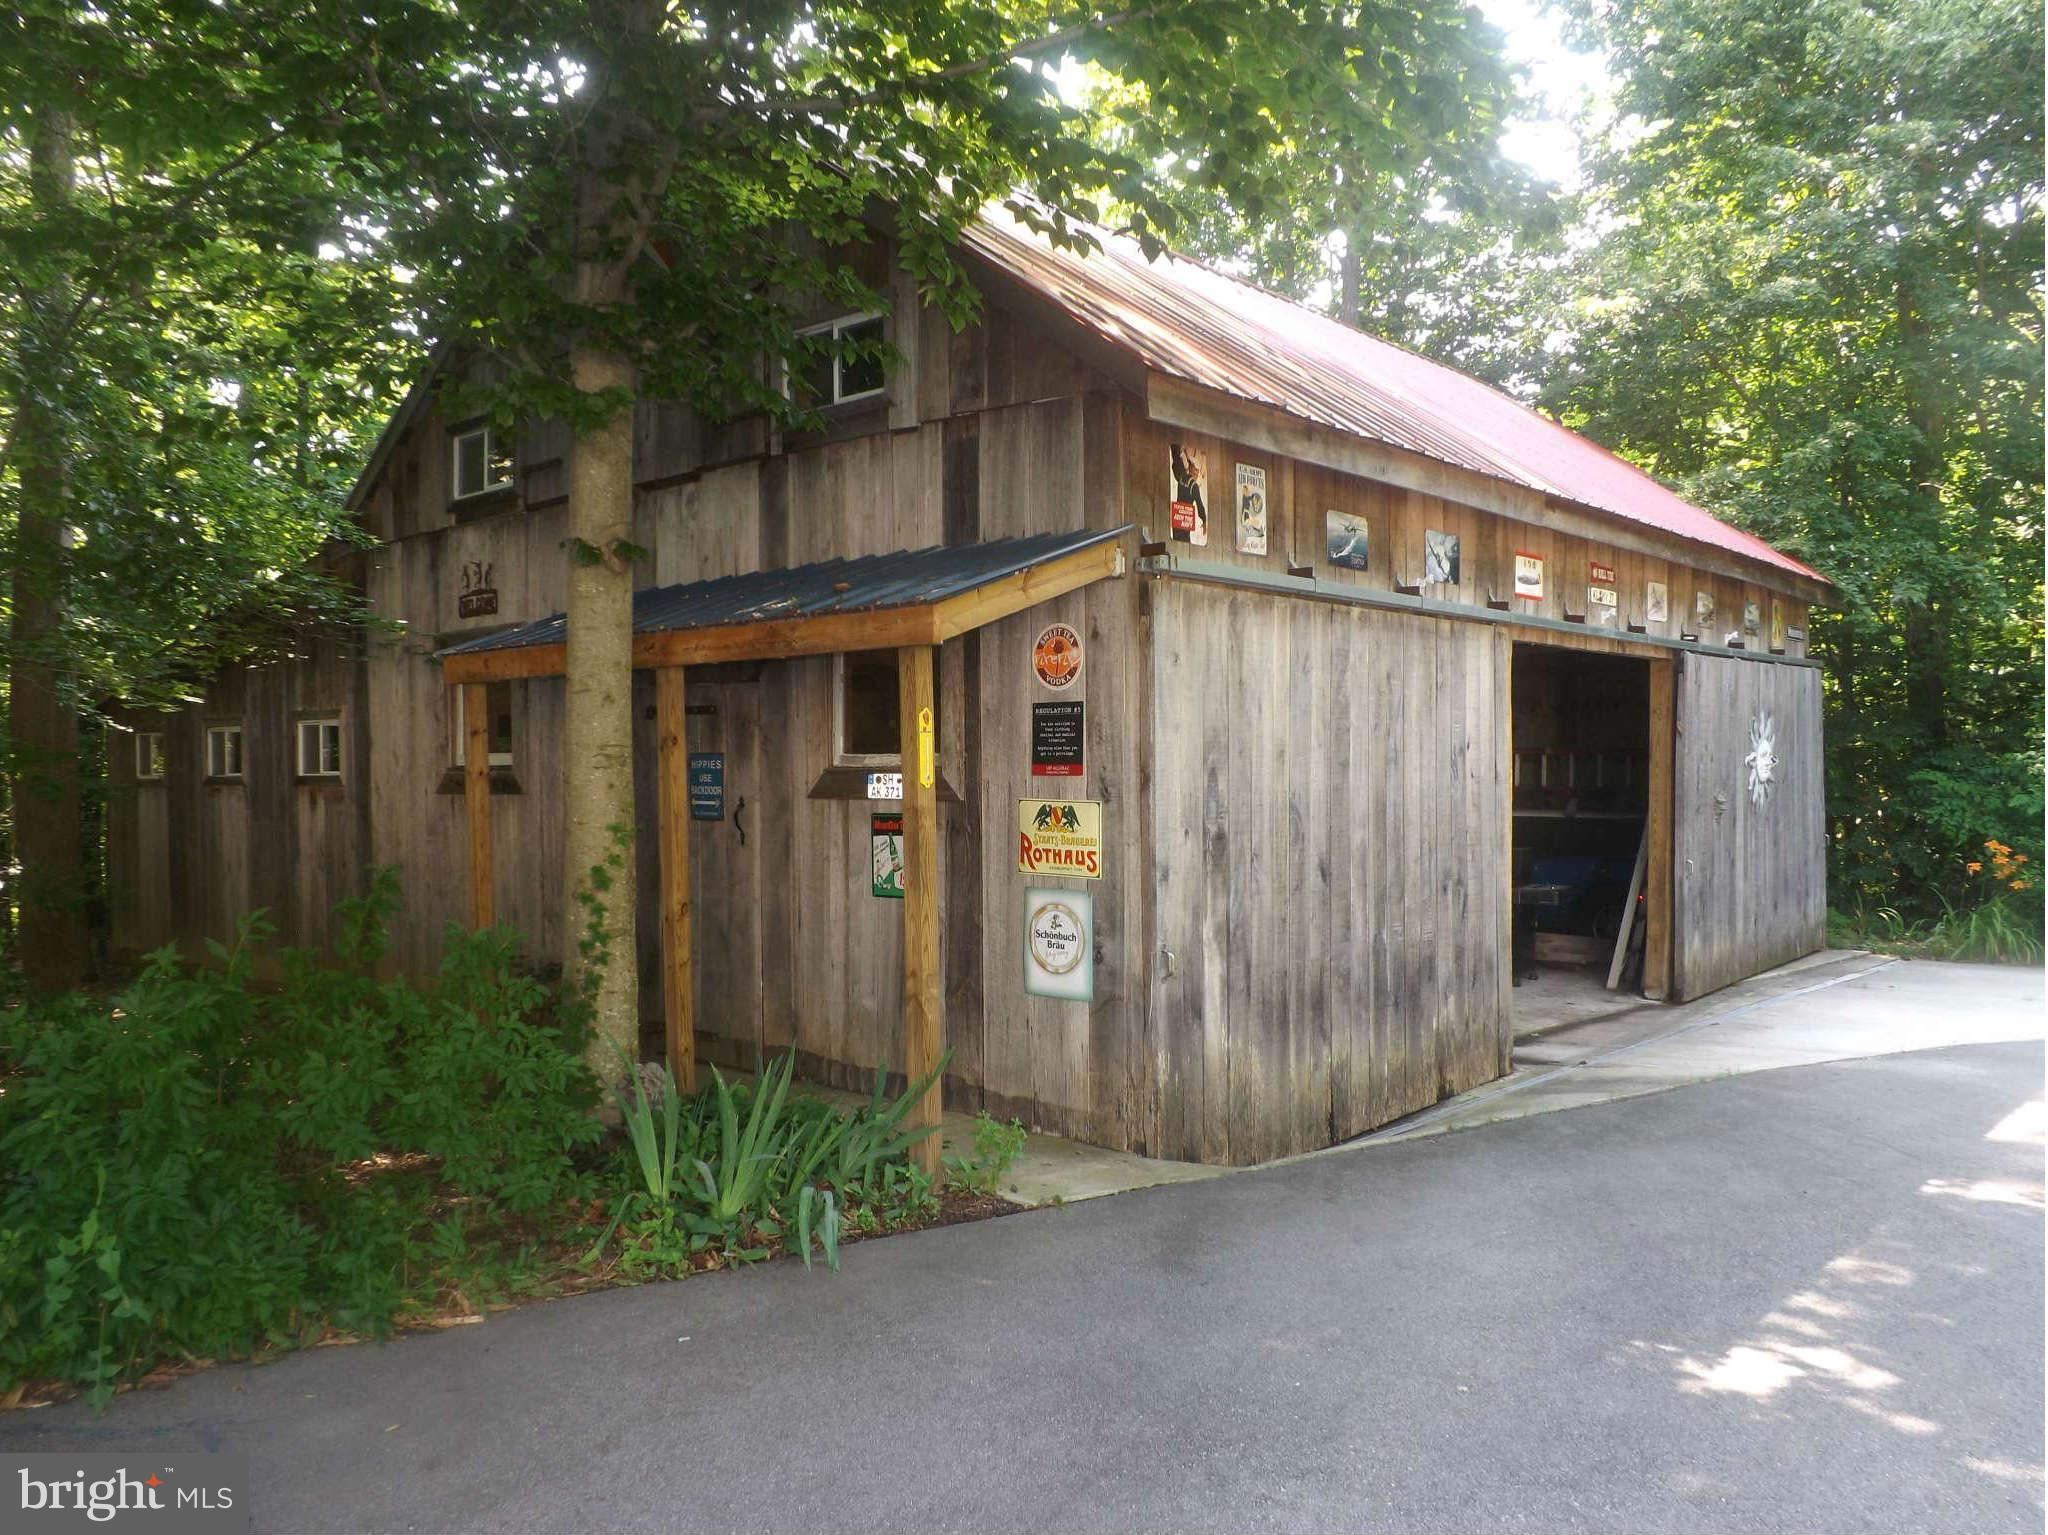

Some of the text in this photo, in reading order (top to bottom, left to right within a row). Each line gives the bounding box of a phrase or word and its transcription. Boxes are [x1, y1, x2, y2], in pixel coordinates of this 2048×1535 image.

[1040, 628, 1062, 645] SWEET
[1046, 674, 1071, 686] VODKA
[1035, 706, 1072, 714] REGULATION
[691, 759, 722, 769] HIPPIES
[699, 774, 712, 783] USE
[882, 774, 894, 785] SH
[871, 786, 901, 798] AK 371
[1020, 832, 1098, 873] ROTHAUS
[1035, 928, 1077, 942] Schönbuch
[1047, 940, 1065, 950] Bräu
